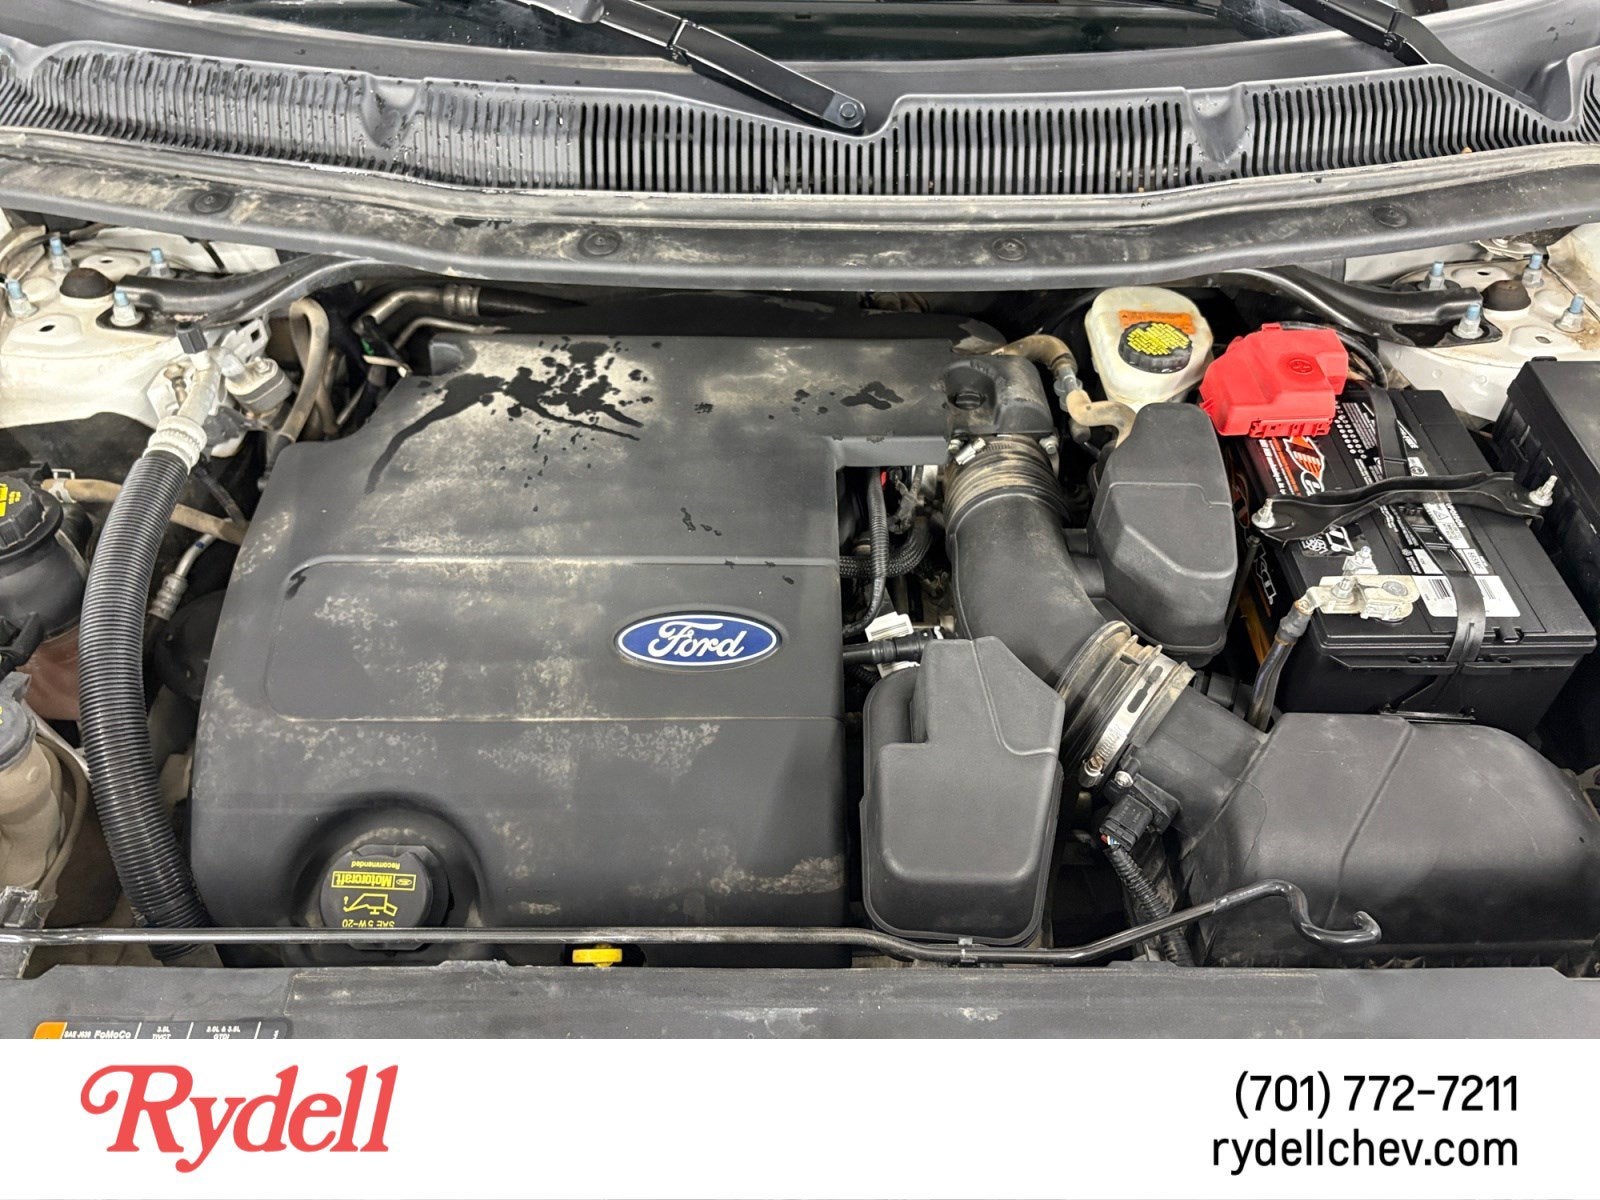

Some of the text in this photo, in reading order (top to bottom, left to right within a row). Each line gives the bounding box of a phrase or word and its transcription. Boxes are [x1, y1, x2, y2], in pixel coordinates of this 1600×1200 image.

[648, 621, 747, 657] Ford
[351, 861, 400, 870] Recommended
[335, 873, 393, 887] Motorcraft
[376, 920, 395, 928] SAE
[94, 1030, 132, 1039] FoMoCo
